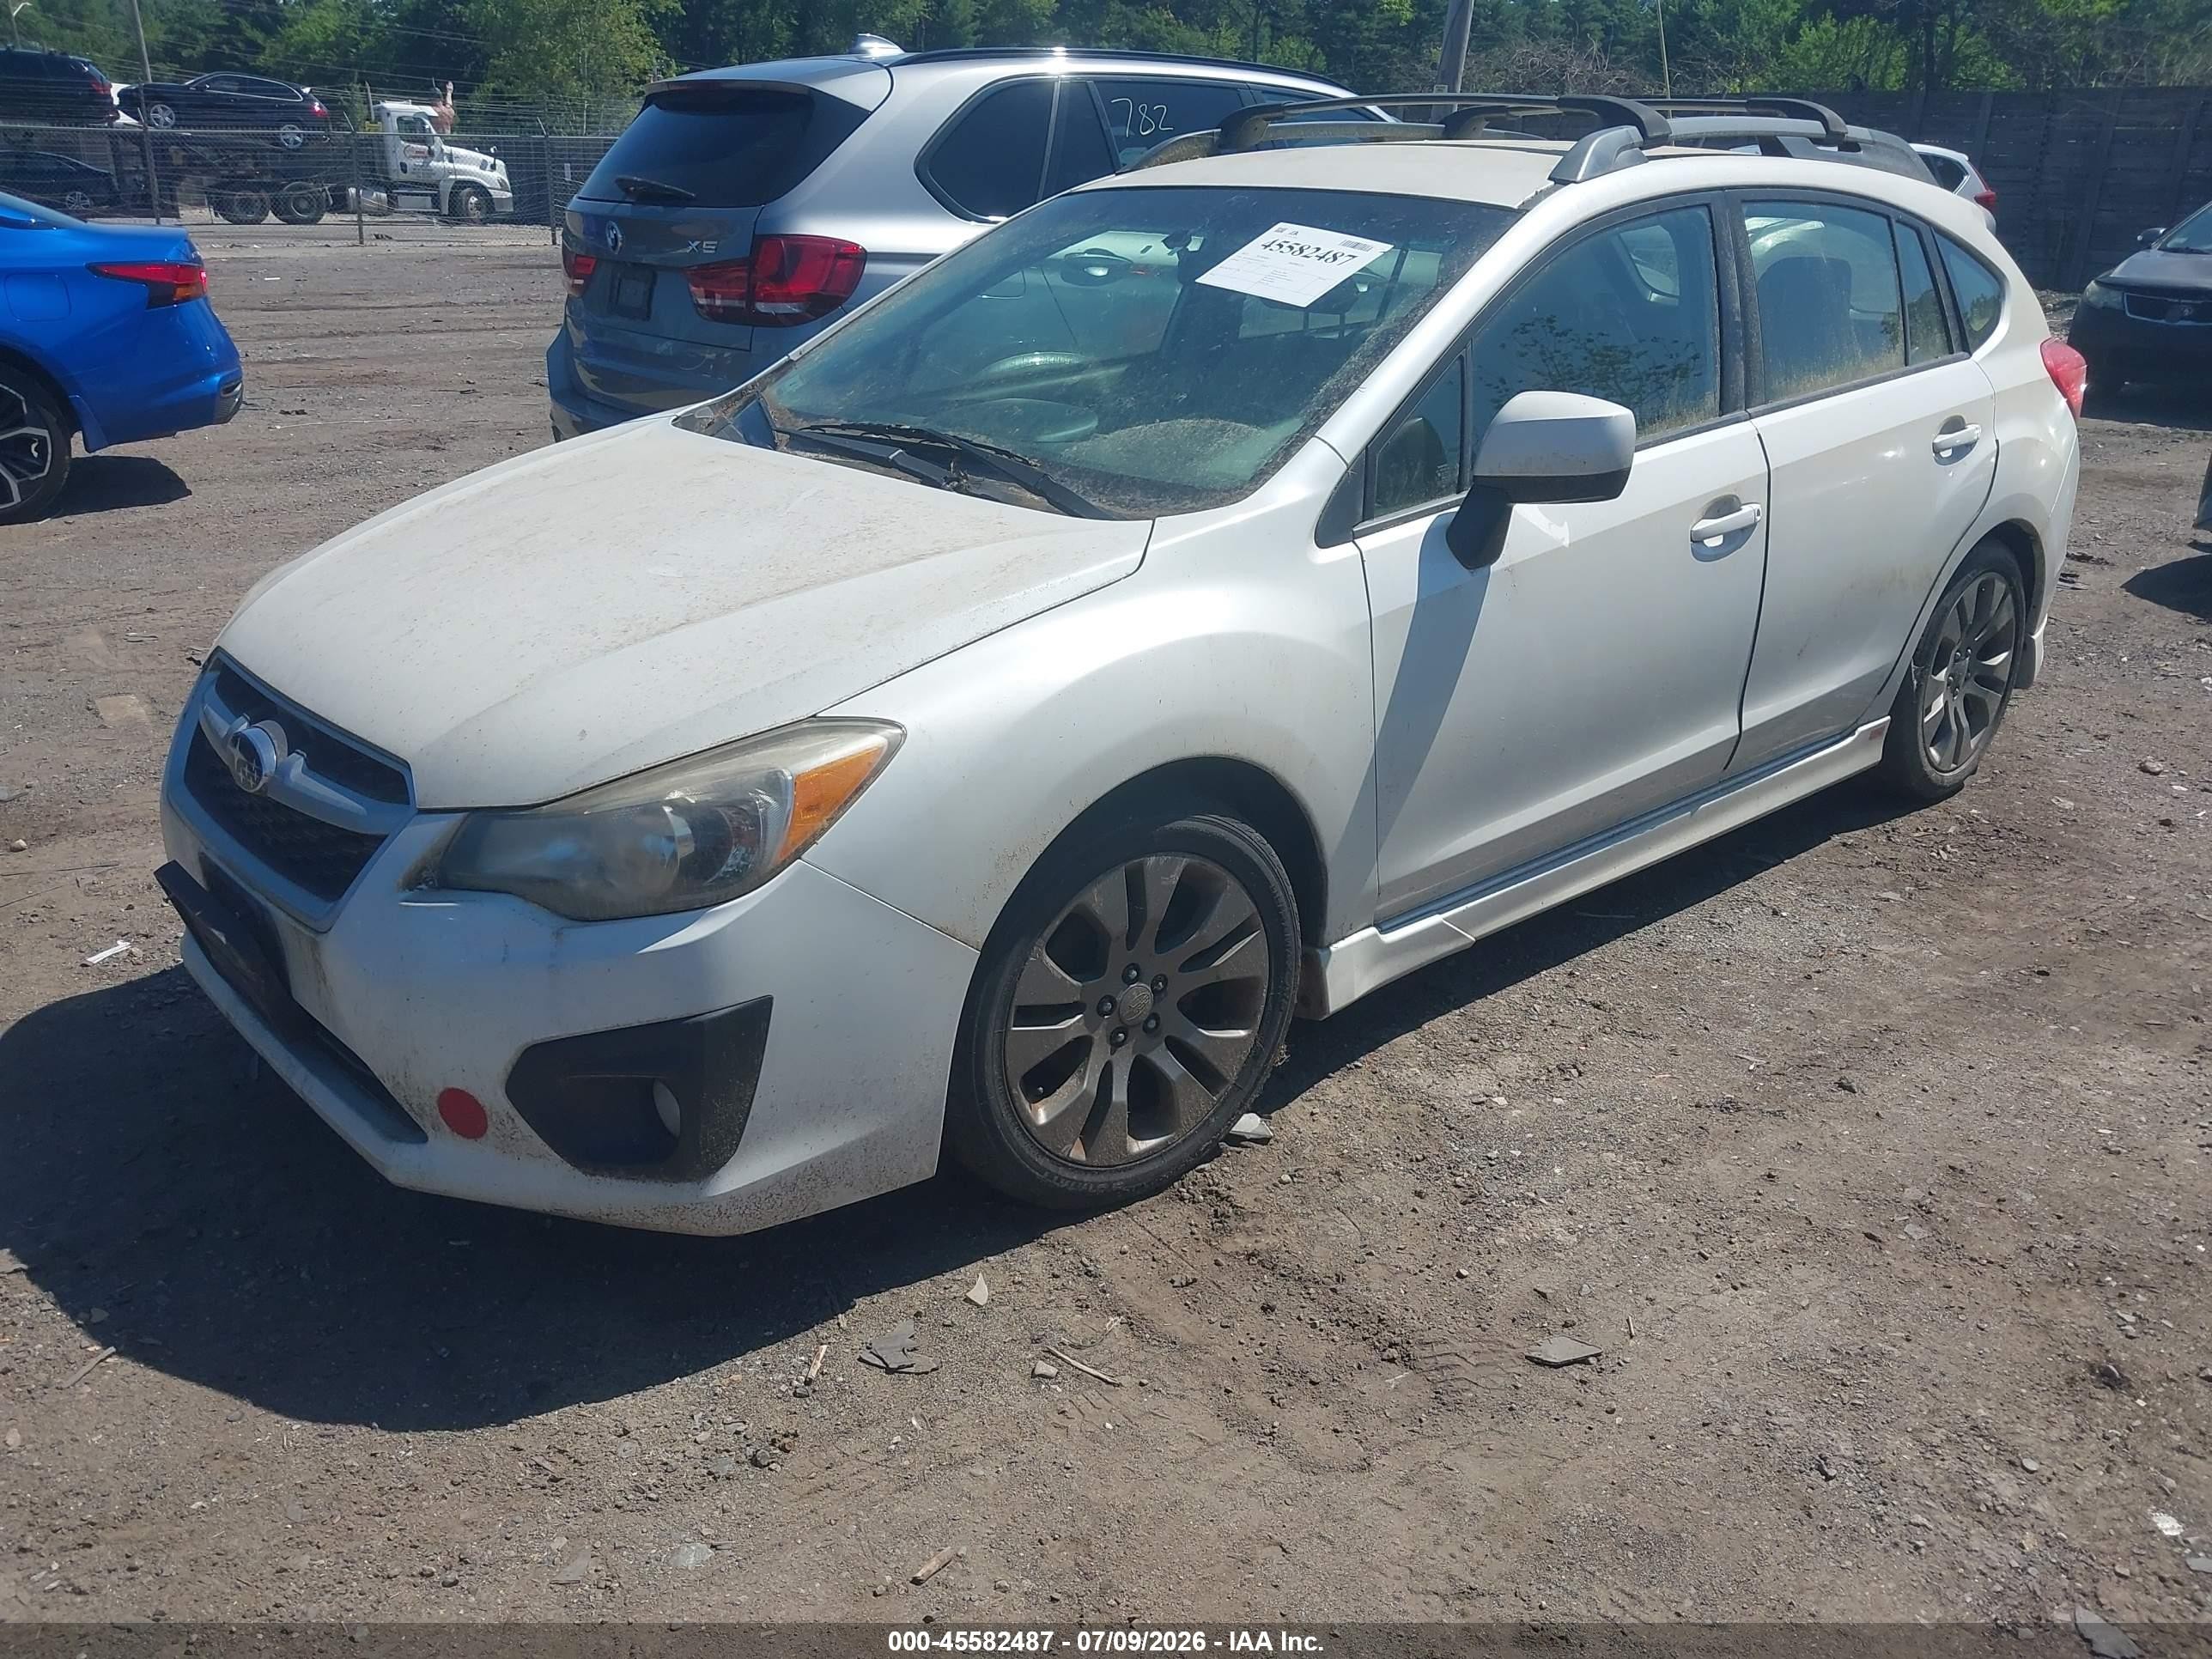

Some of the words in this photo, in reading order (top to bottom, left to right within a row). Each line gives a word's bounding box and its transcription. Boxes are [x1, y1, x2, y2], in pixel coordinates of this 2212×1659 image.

[1110, 98, 1174, 137] 782
[687, 240, 718, 253] X5
[1261, 239, 1358, 266] 45582487
